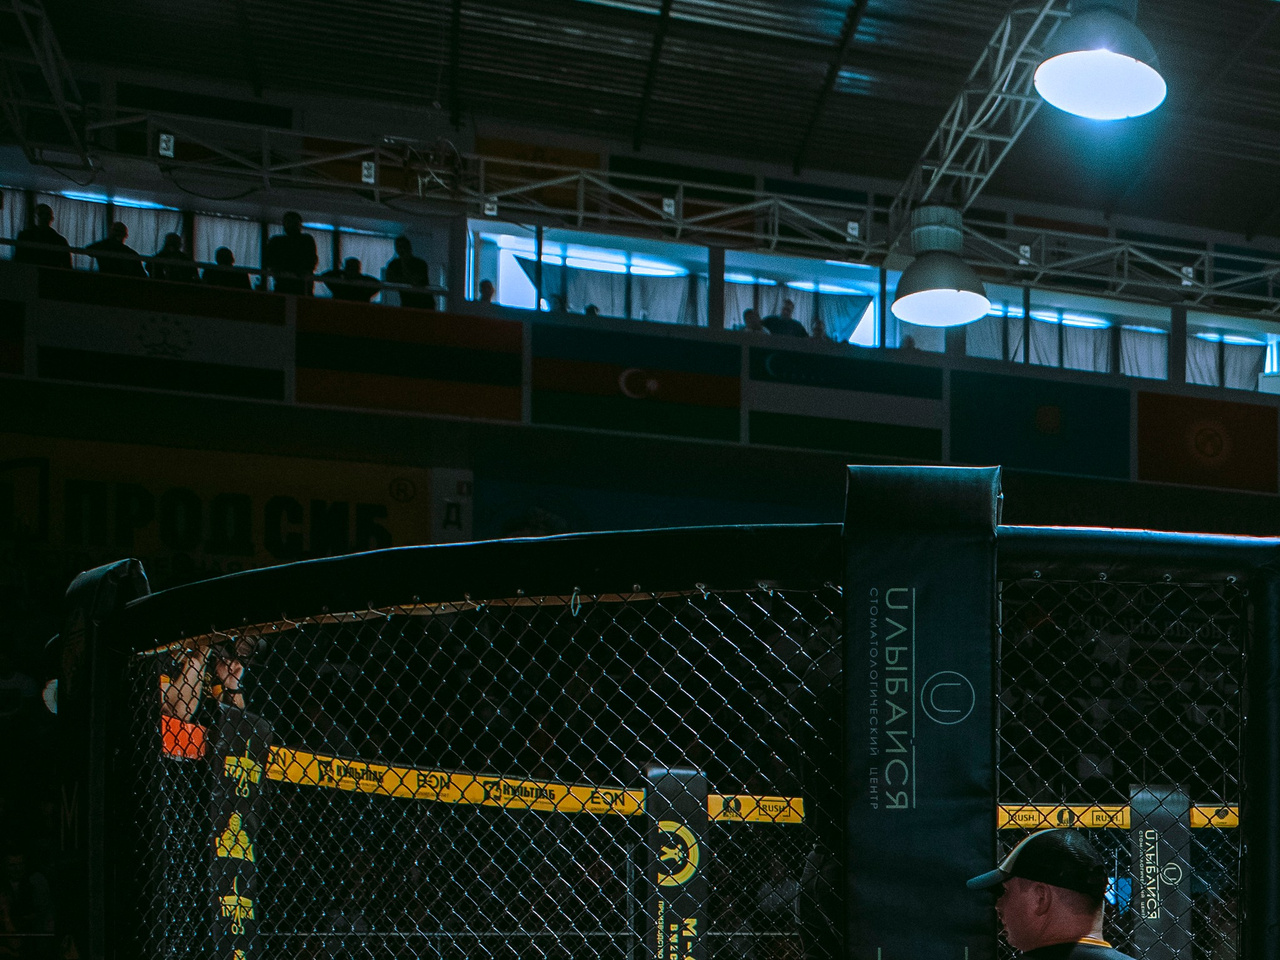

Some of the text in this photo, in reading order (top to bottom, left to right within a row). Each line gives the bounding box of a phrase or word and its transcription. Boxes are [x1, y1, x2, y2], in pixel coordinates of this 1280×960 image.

[868, 587, 880, 810] СТОМАТОЛОГИЧЕСКИЙ ЦЕНТР
[590, 790, 626, 807] EON
